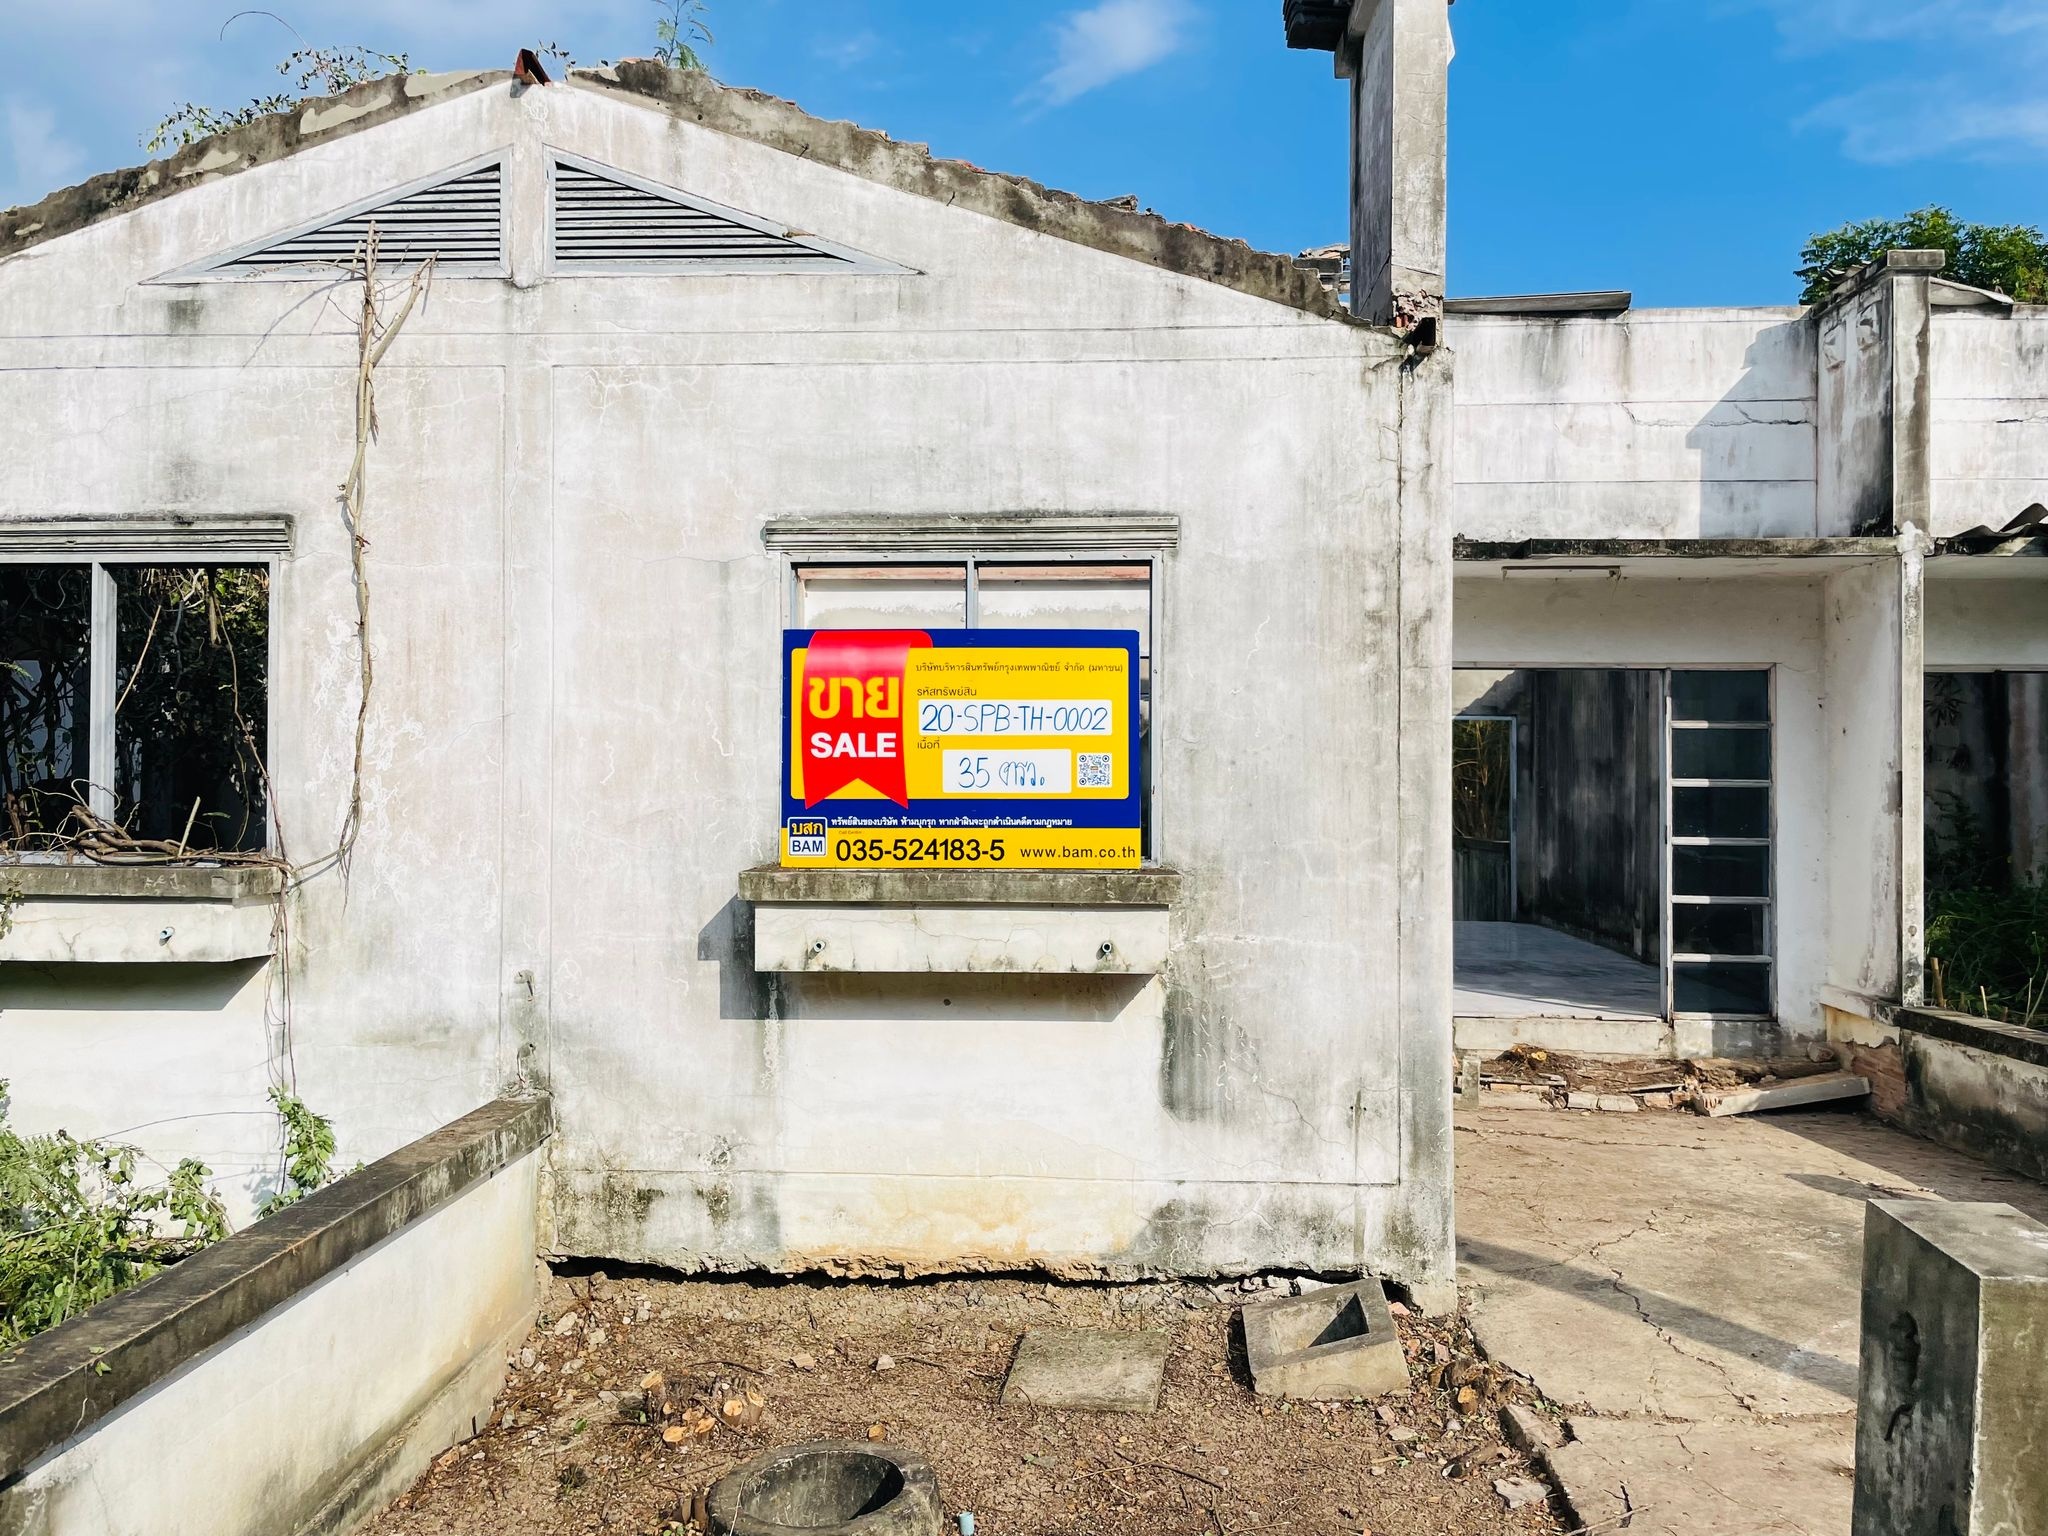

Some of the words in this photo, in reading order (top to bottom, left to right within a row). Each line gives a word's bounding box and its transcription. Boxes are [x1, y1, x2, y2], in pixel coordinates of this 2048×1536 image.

[1064, 662, 1085, 673] จำกัด
[1088, 664, 1123, 674] (มหาชน)
[809, 677, 899, 718] ขาย
[917, 686, 977, 697] รหัสทรัพย์สิน
[922, 704, 1108, 732] 20-SPB-TH-0002
[811, 732, 896, 758] SALE
[917, 737, 940, 750] เนื้อที่
[958, 757, 990, 788] 35
[792, 821, 823, 835] บสก
[831, 816, 898, 826] ทรัพย์สินของบริษัท
[901, 816, 936, 828] ห้ามบุกรุก
[792, 840, 823, 853] BAM
[836, 838, 1004, 861] 035-524183-5
[1020, 846, 1136, 858] www.bam.co.th
